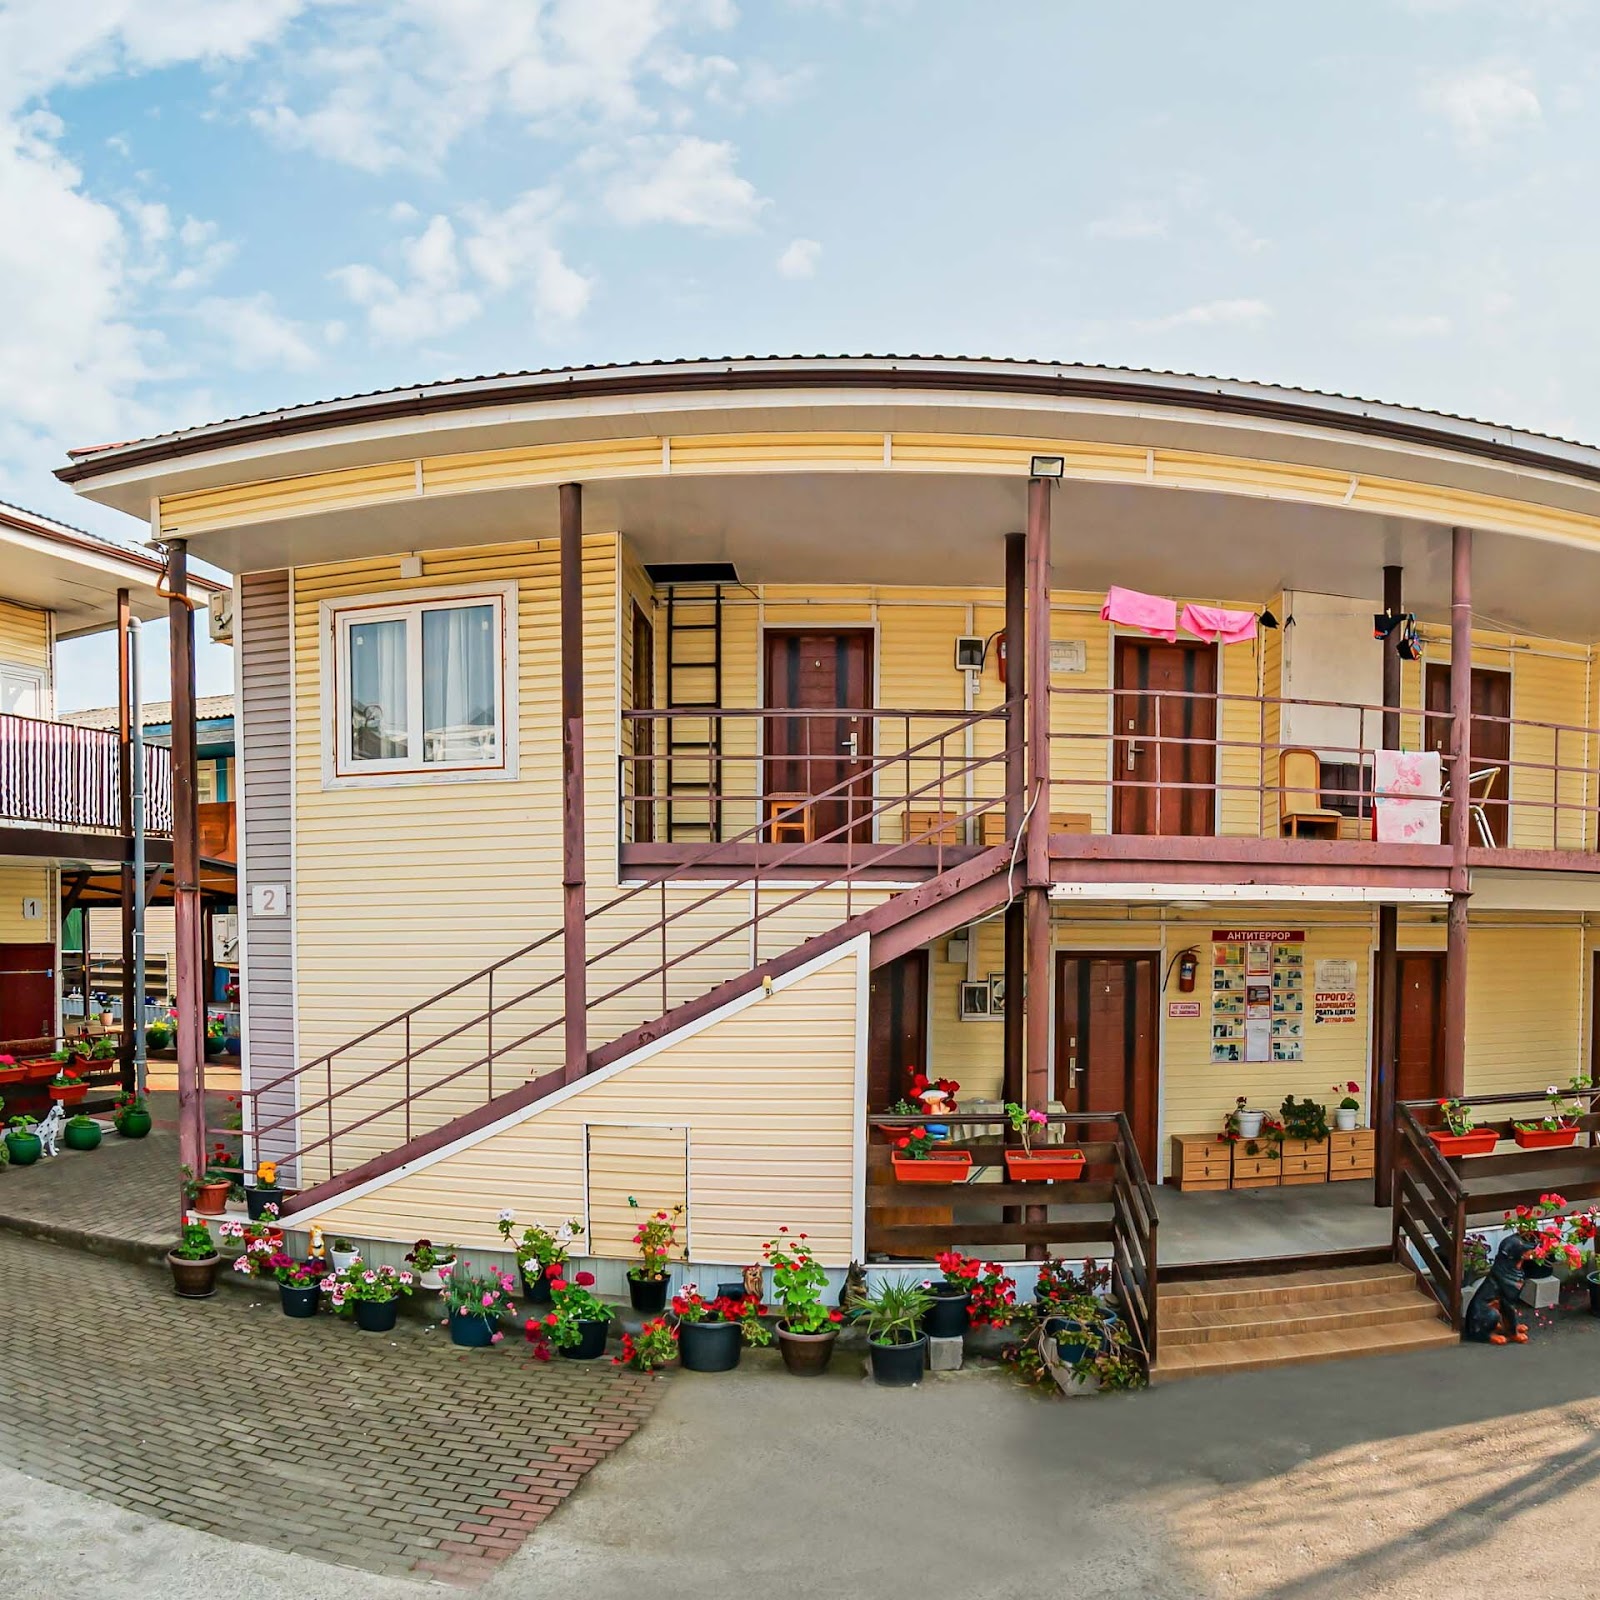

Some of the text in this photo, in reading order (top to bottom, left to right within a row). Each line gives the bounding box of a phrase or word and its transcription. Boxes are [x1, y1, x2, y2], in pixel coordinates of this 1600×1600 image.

[263, 889, 275, 911] 2
[29, 901, 35, 916] 1
[1227, 931, 1291, 940] АНТИТЕРРОР
[1315, 992, 1346, 1001] СТРОГО
